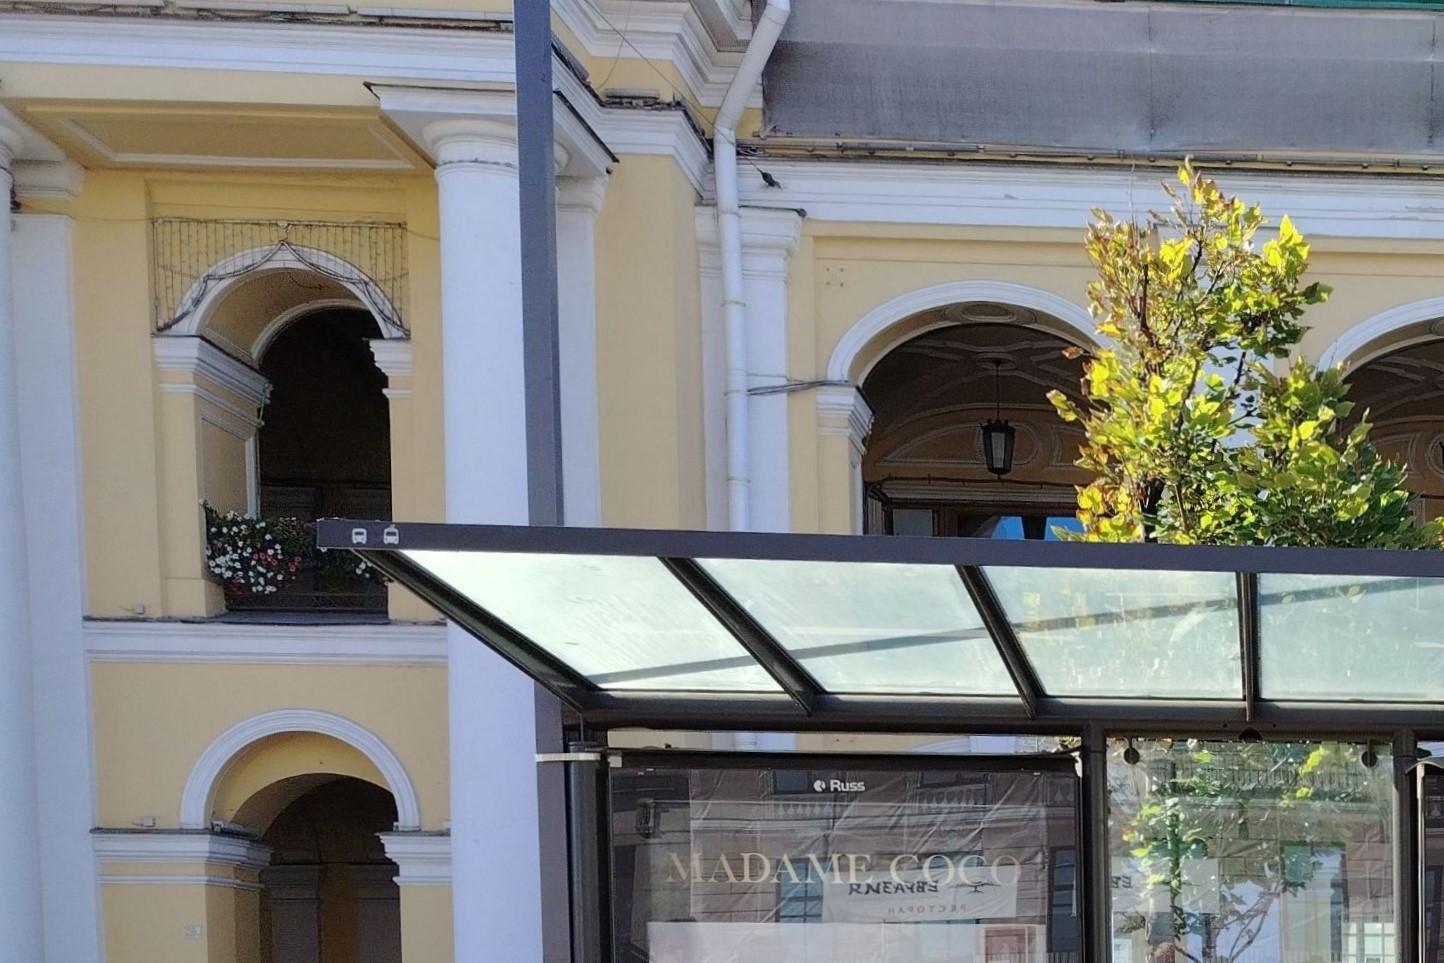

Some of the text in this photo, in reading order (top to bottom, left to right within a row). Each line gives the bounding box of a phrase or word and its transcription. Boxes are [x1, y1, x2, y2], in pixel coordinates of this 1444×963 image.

[829, 778, 866, 793] Russ
[665, 851, 1022, 887] MADAME COCO
